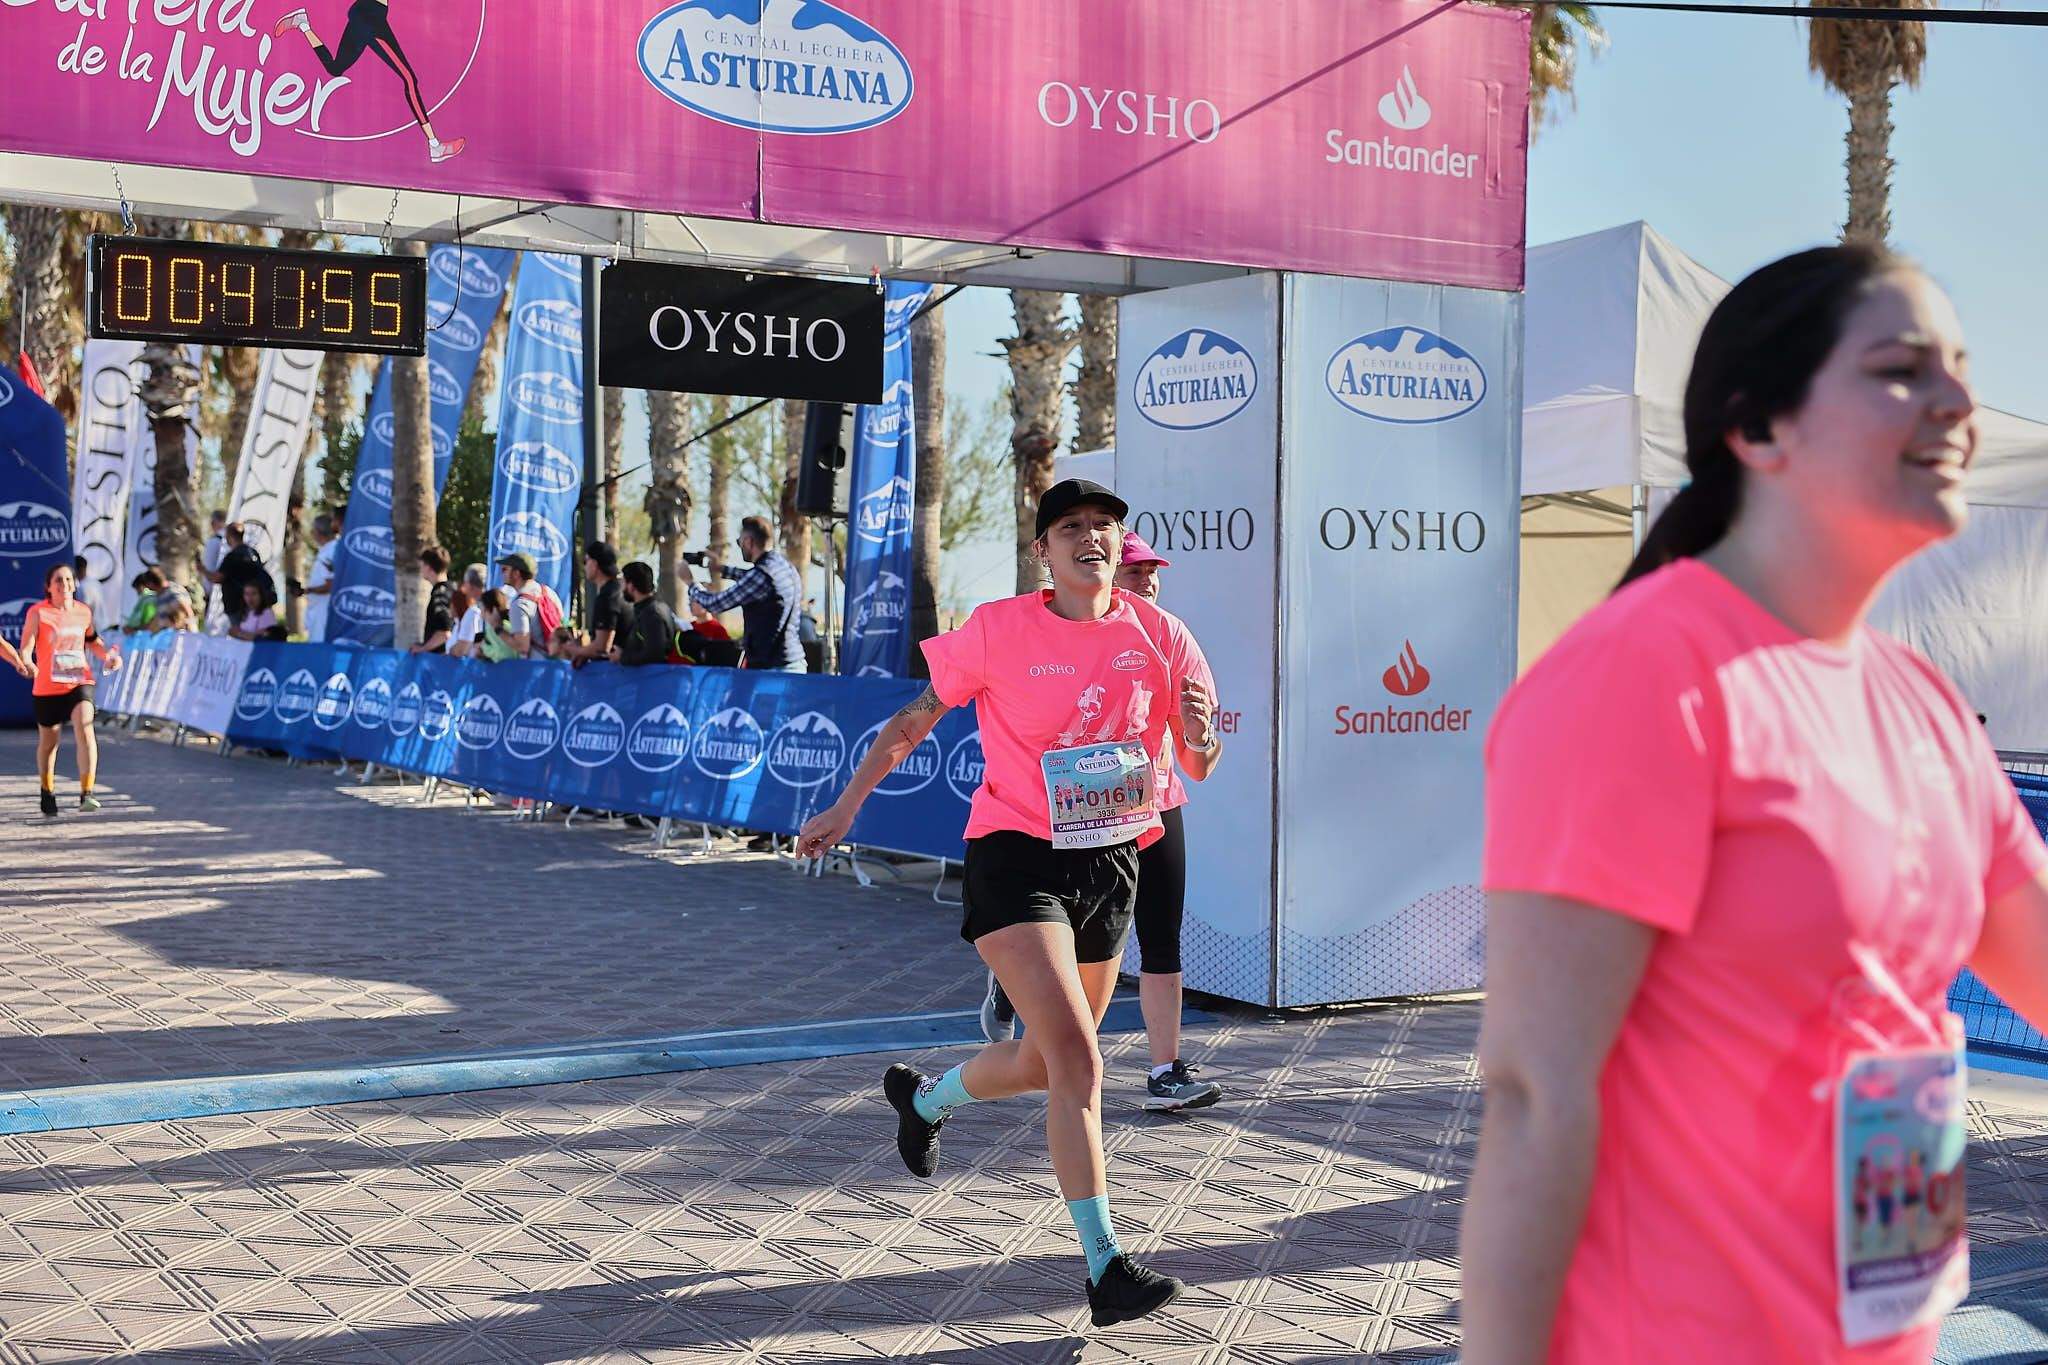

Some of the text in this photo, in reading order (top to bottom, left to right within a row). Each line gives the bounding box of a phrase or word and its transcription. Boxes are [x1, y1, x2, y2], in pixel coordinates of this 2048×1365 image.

[704, 29, 885, 64] CENTRAL LECHERA
[57, 21, 352, 156] de la Mujer
[1037, 81, 1221, 144] OYSHO
[1325, 128, 1479, 178] Santander
[116, 253, 402, 336] 00:41:55
[648, 304, 847, 363] OYSHO
[1134, 507, 1255, 552] OYSHO
[1319, 507, 1486, 553] OYSHO
[1029, 663, 1075, 677] OYSHO
[1335, 704, 1472, 735] Santander
[1086, 787, 1126, 807] 016
[1097, 808, 1116, 818] 3936
[1058, 822, 1086, 831] CARRERA
[1104, 817, 1122, 826] MUJER
[1065, 833, 1101, 844] OYSHO
